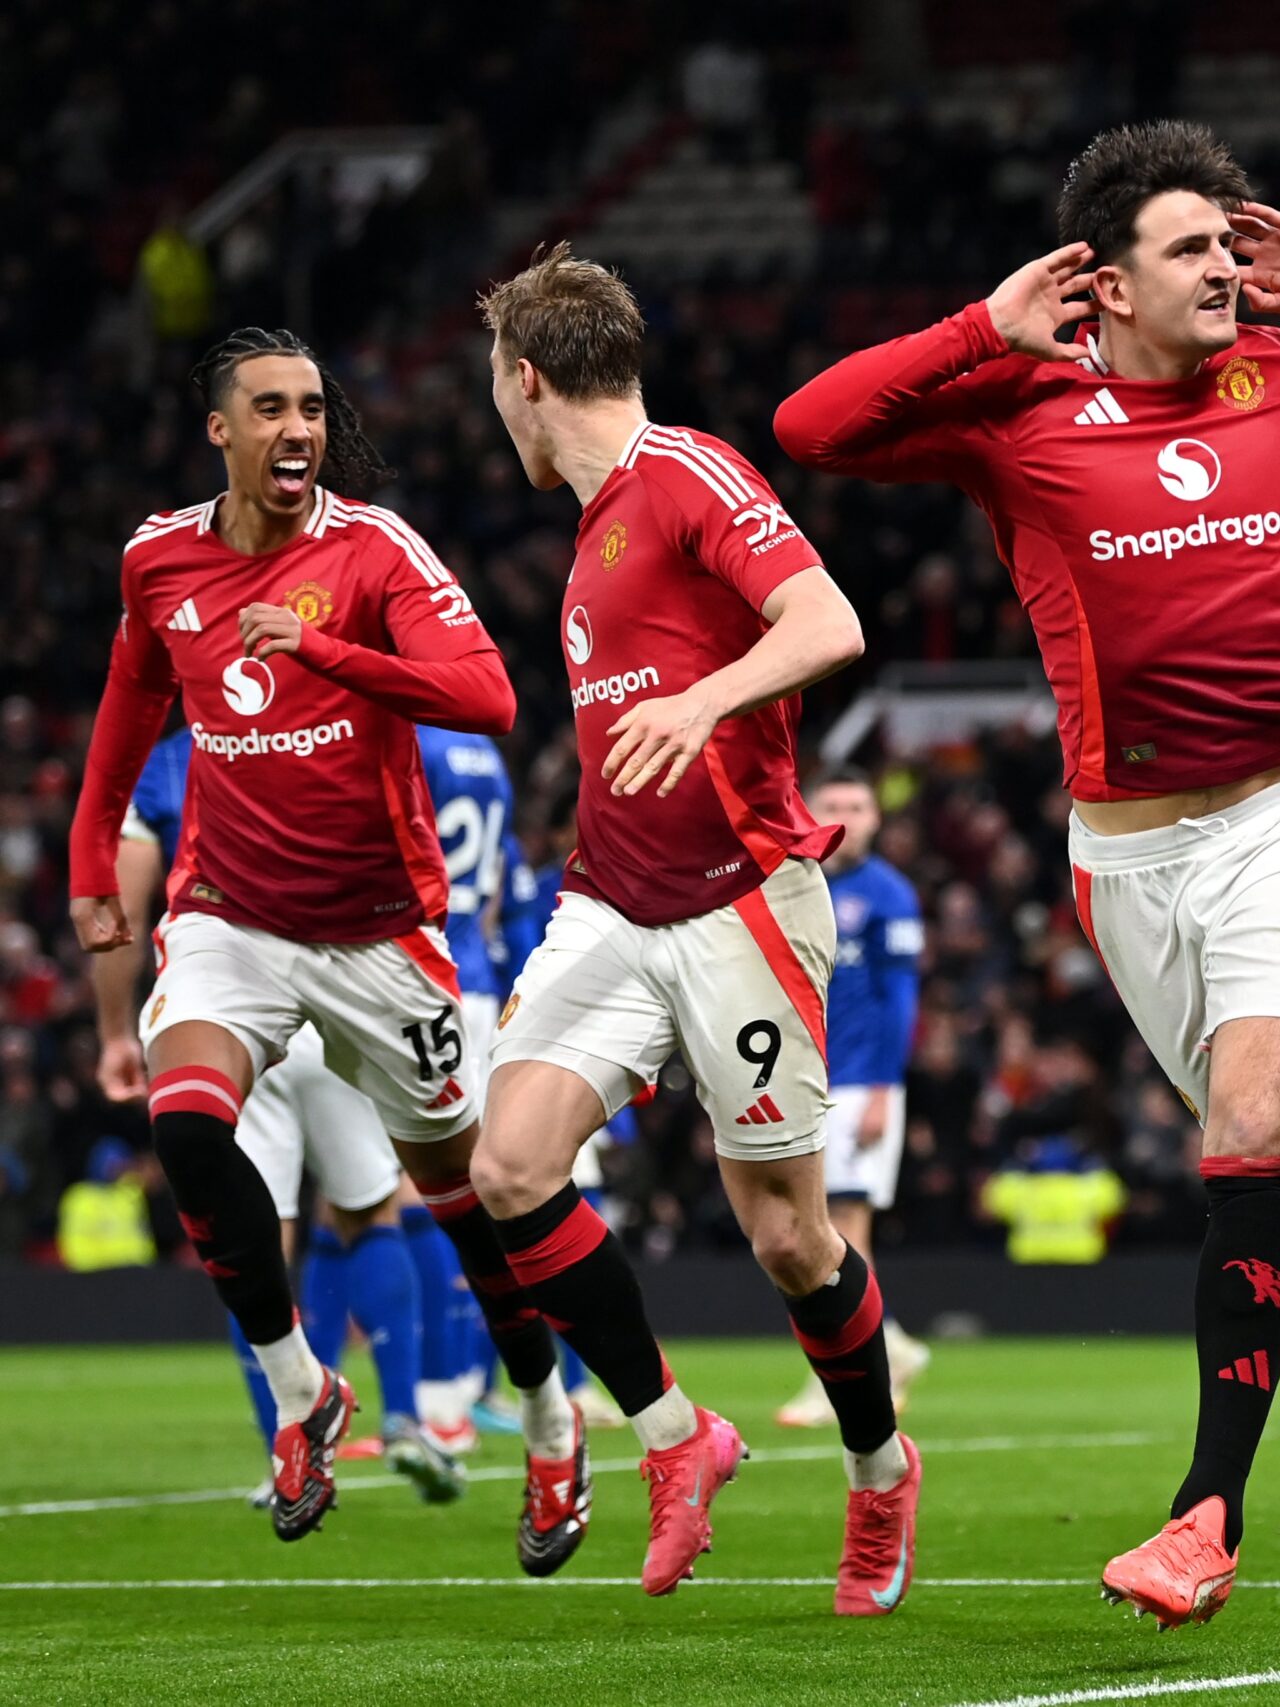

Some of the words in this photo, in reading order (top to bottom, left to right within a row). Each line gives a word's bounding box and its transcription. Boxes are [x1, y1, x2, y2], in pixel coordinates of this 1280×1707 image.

[751, 527, 804, 556] TECHNO
[571, 666, 660, 712] pdragon
[402, 1004, 462, 1081] 15
[736, 1019, 782, 1089] 9
